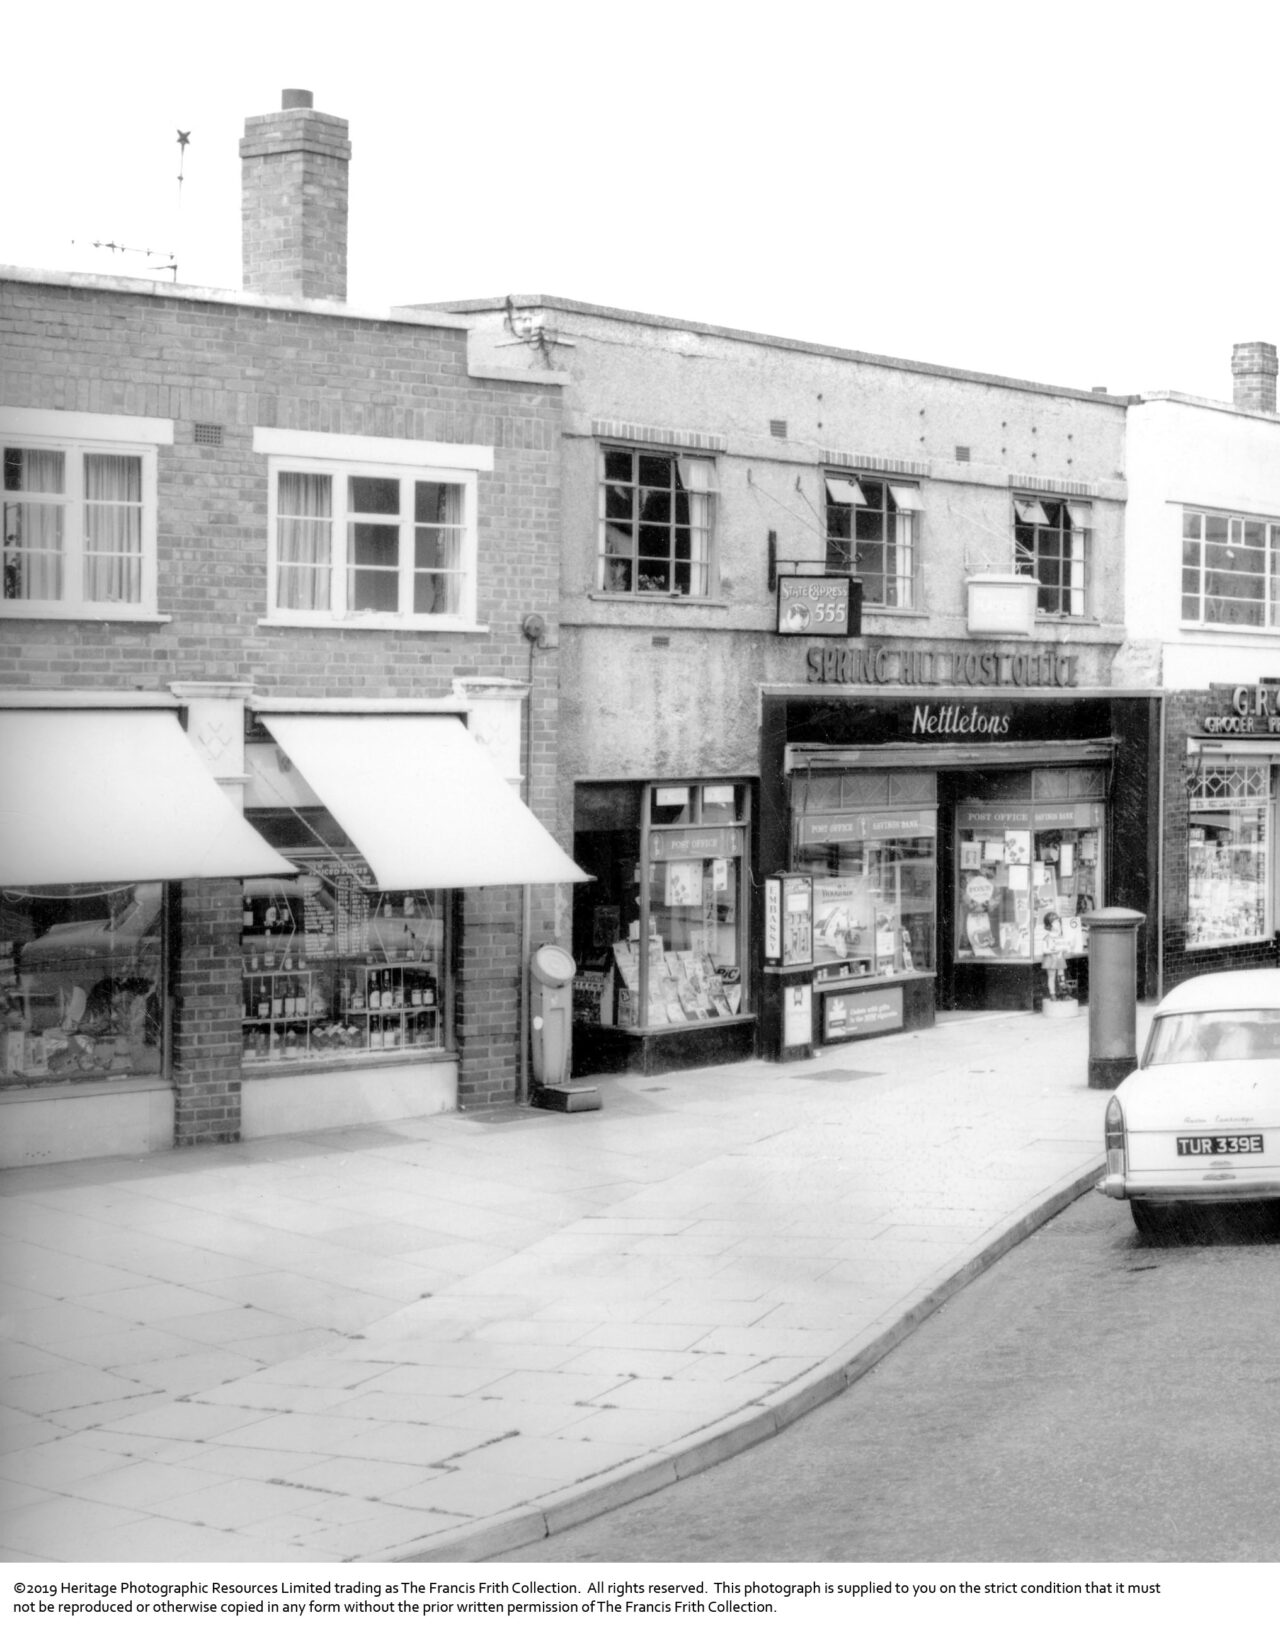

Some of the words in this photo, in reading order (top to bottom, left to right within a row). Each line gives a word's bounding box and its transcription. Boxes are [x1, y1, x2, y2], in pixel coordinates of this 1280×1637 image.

[815, 603, 846, 622] 555
[806, 646, 889, 685] SPRING
[899, 649, 940, 686] HILL
[951, 650, 1002, 686] POST
[1011, 650, 1079, 687] OFFICE
[911, 704, 1011, 736] Nettletons
[1204, 716, 1255, 733] GROCER
[967, 813, 991, 822] POST
[994, 812, 1028, 822] OFFICE
[829, 822, 854, 833] OFFICE
[671, 839, 690, 849] POST
[691, 838, 718, 849] OFFICE
[768, 885, 778, 951] EMBASSY
[1178, 1138, 1212, 1154] TUR
[1215, 1136, 1262, 1153] 339E
